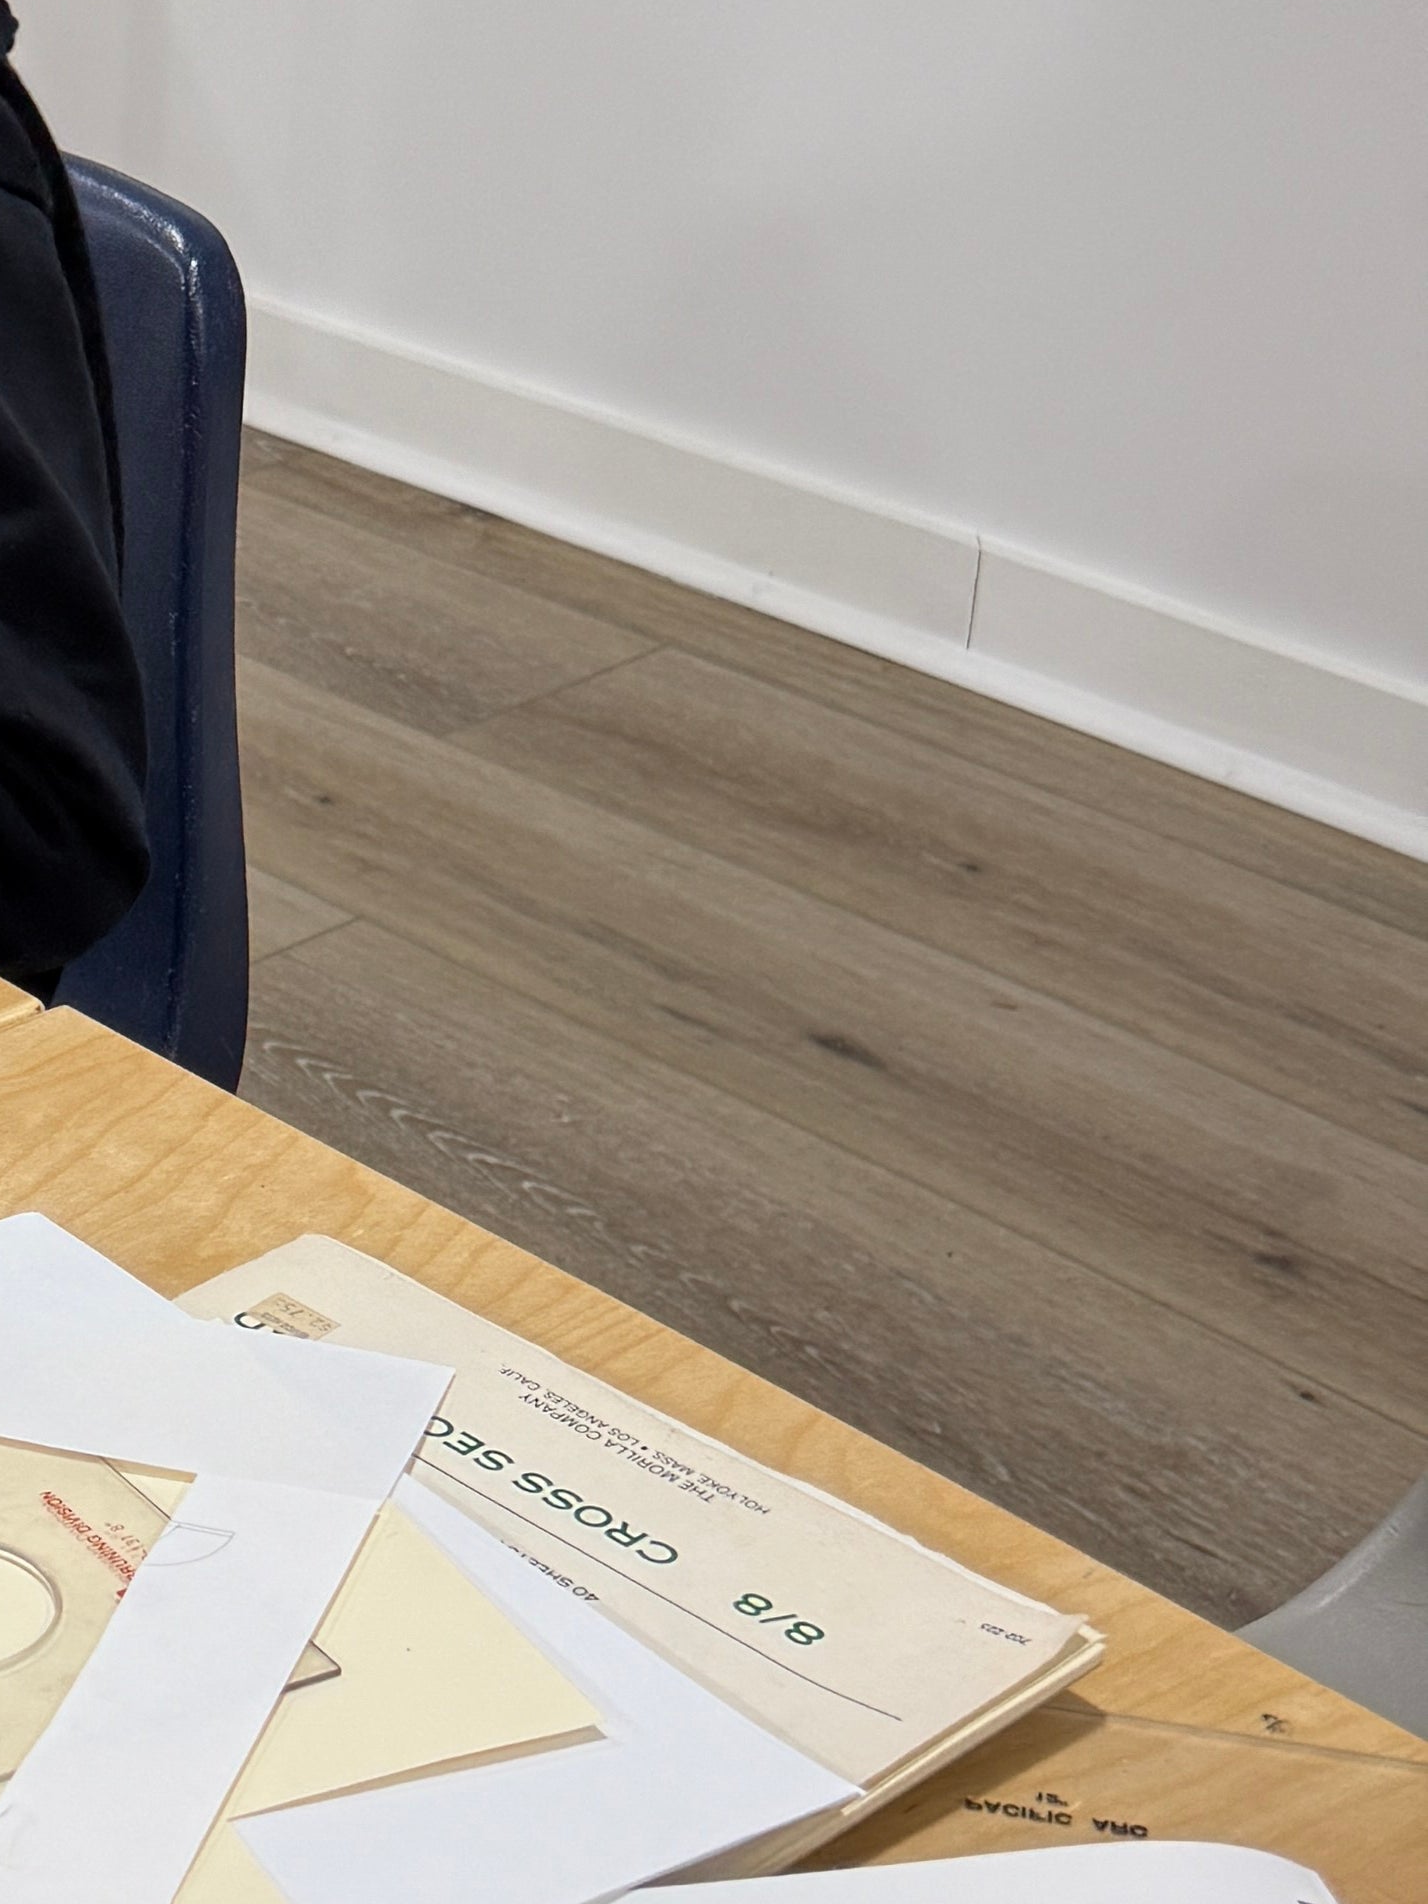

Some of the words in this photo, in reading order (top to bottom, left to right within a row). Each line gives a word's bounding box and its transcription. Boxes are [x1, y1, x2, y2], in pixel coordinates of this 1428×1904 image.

[519, 1393, 602, 1439] COMPANY
[607, 1428, 638, 1448] LOS
[605, 1439, 678, 1483] MORILLA
[40, 1490, 87, 1534] DIVISION
[680, 1480, 716, 1504] THE
[512, 1472, 679, 1565] CROSS
[733, 1592, 825, 1646] 8/8
